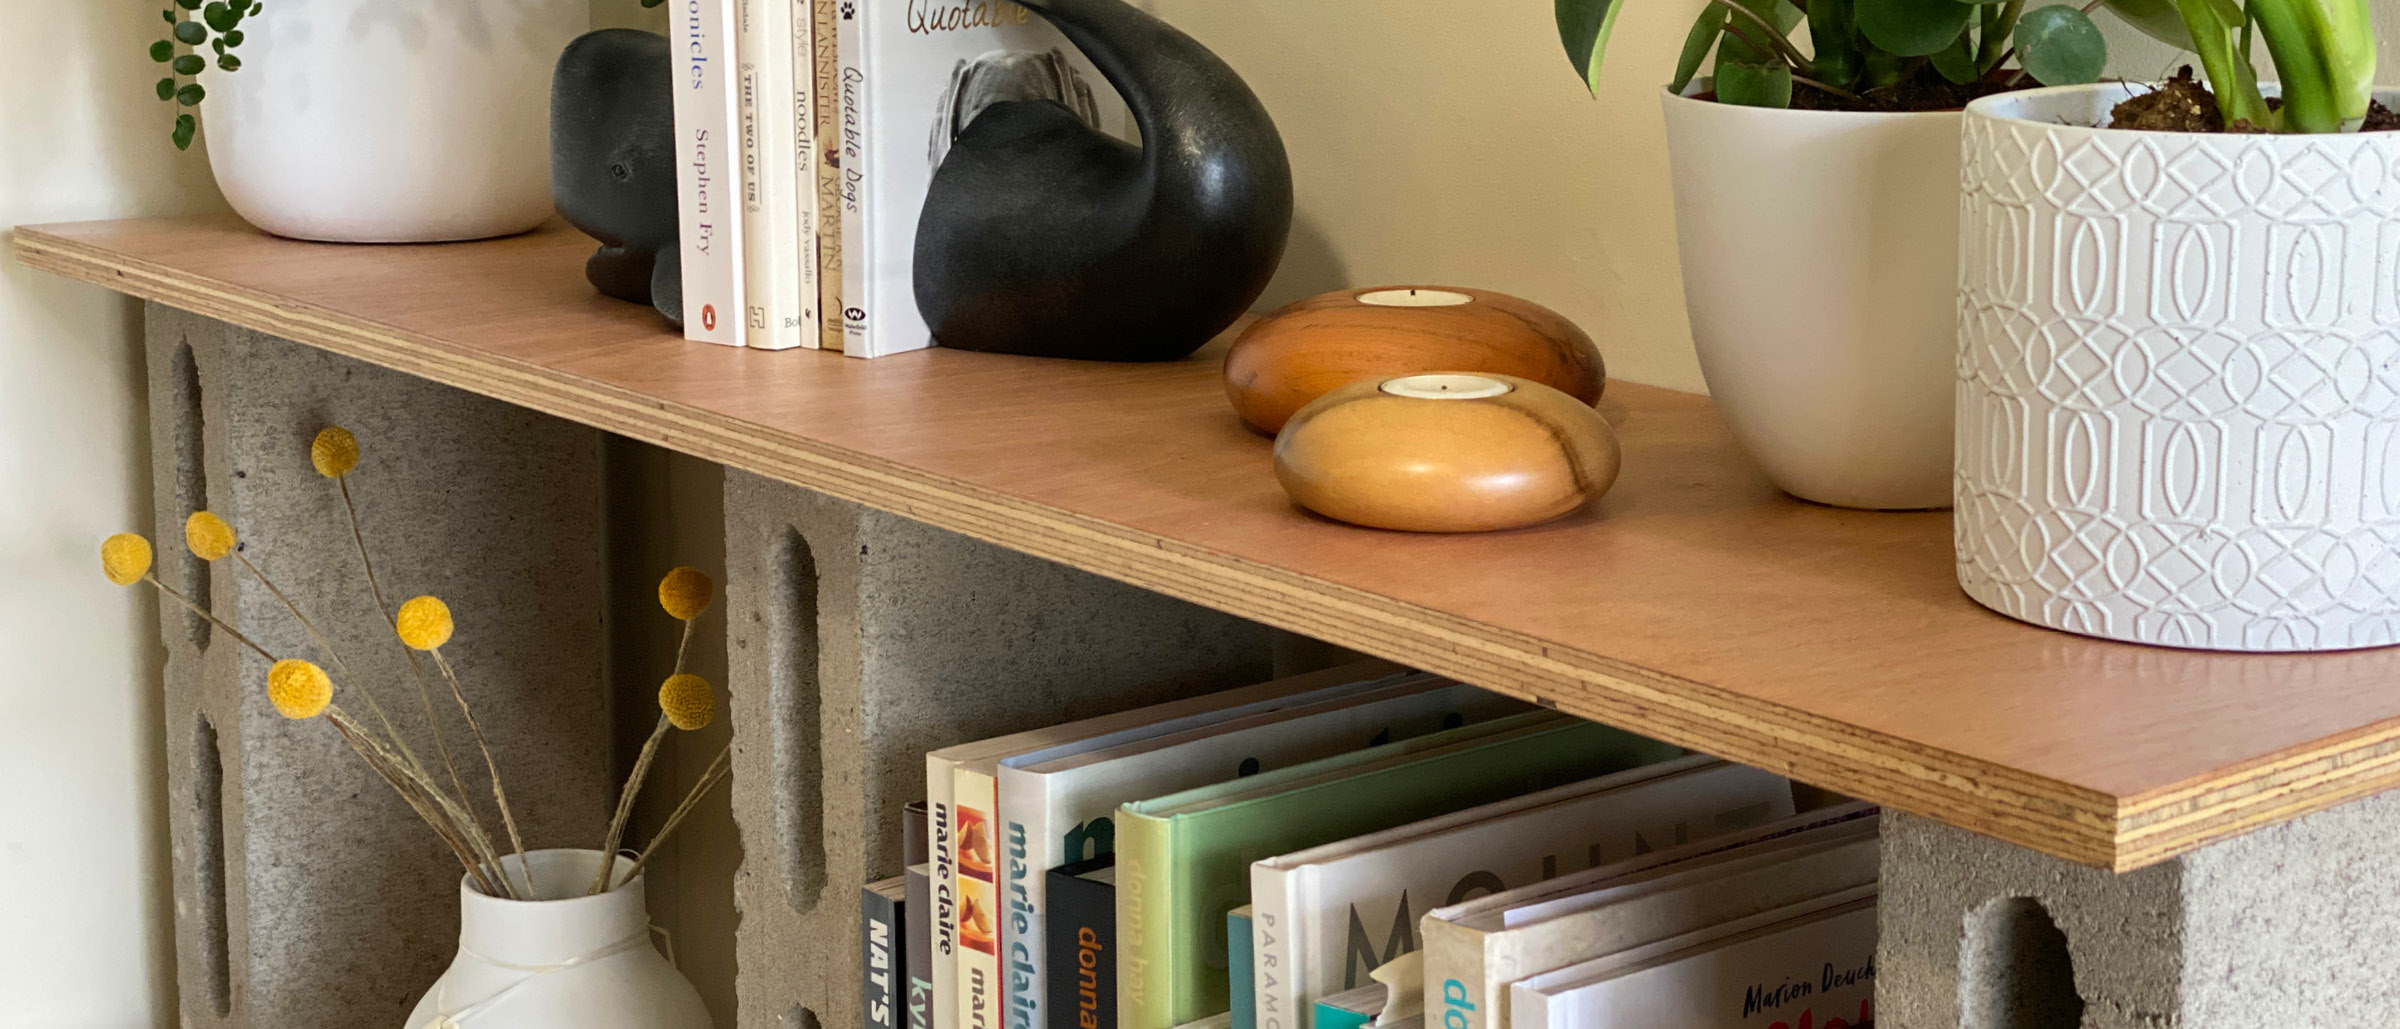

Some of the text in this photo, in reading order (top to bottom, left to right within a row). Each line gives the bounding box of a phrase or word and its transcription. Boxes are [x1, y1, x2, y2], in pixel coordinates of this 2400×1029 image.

[794, 17, 809, 57] style
[907, 0, 1028, 35] Quotable
[817, 22, 830, 126] LANNISTER
[744, 74, 756, 202] THE TWO OF US
[796, 91, 811, 171] noodles
[840, 67, 863, 213] Quotable Dogs
[693, 129, 713, 256] Stephen Fry
[801, 211, 811, 235] jody
[821, 176, 836, 271] MARTIN
[935, 802, 956, 955] marie claire
[1008, 821, 1037, 1029] marie clair
[870, 918, 890, 1027] NAT'S
[1078, 926, 1103, 1029] donna
[1126, 859, 1149, 1006] donna hay
[1743, 976, 1813, 1019] Marion
